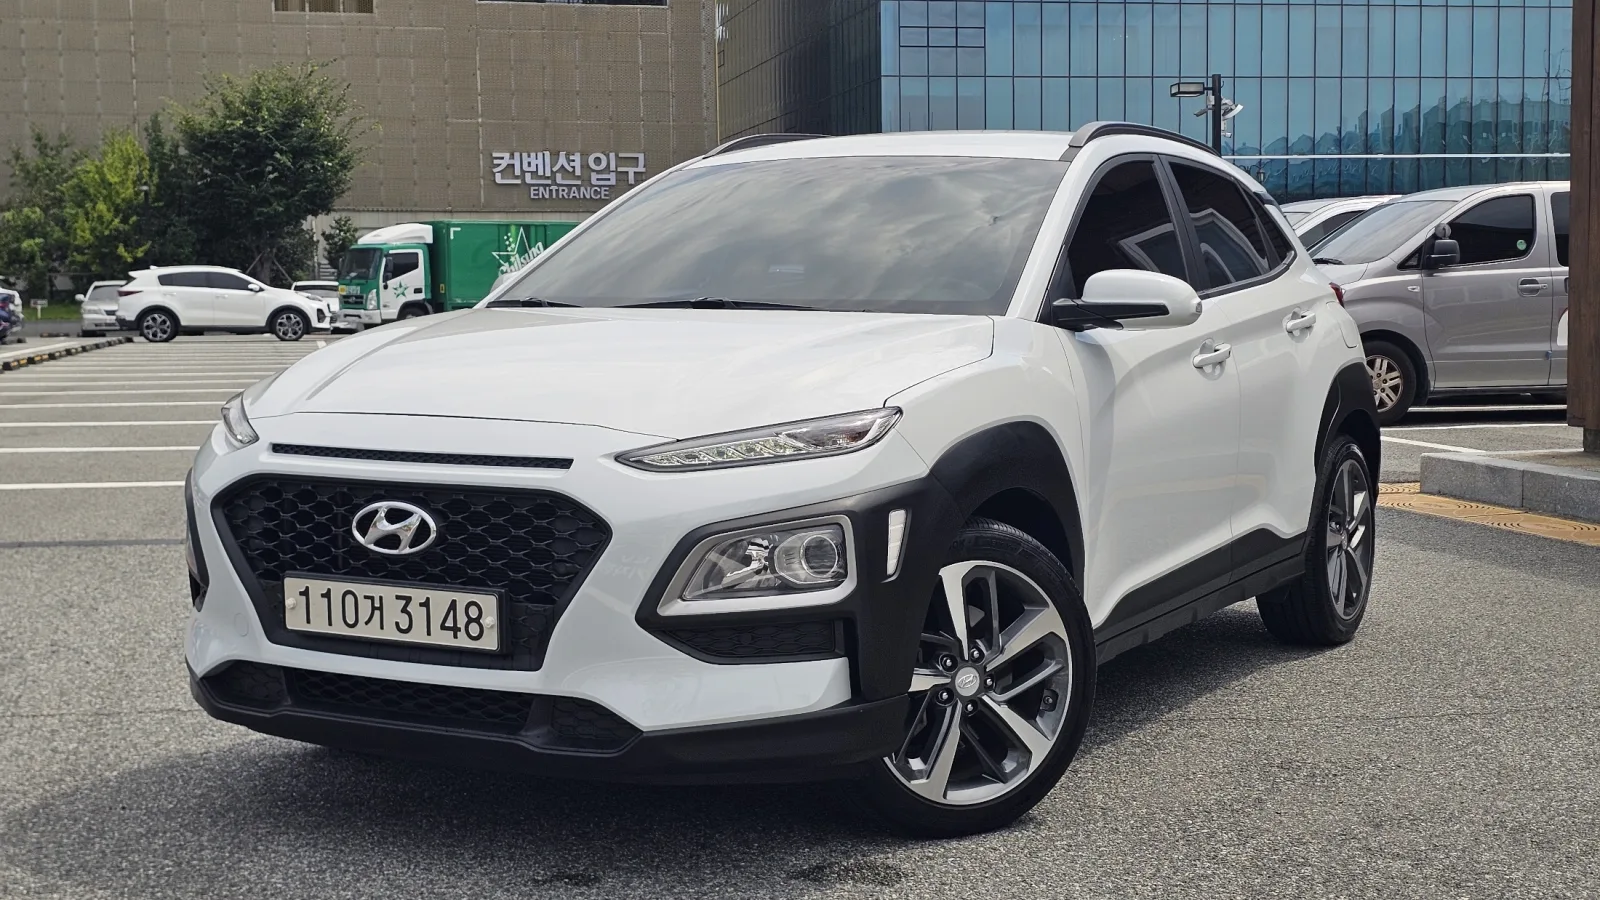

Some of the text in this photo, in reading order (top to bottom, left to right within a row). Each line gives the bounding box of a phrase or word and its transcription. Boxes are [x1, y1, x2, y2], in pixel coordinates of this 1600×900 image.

[492, 151, 646, 185] 컨벤션 입구
[530, 186, 610, 199] ENTRANCE
